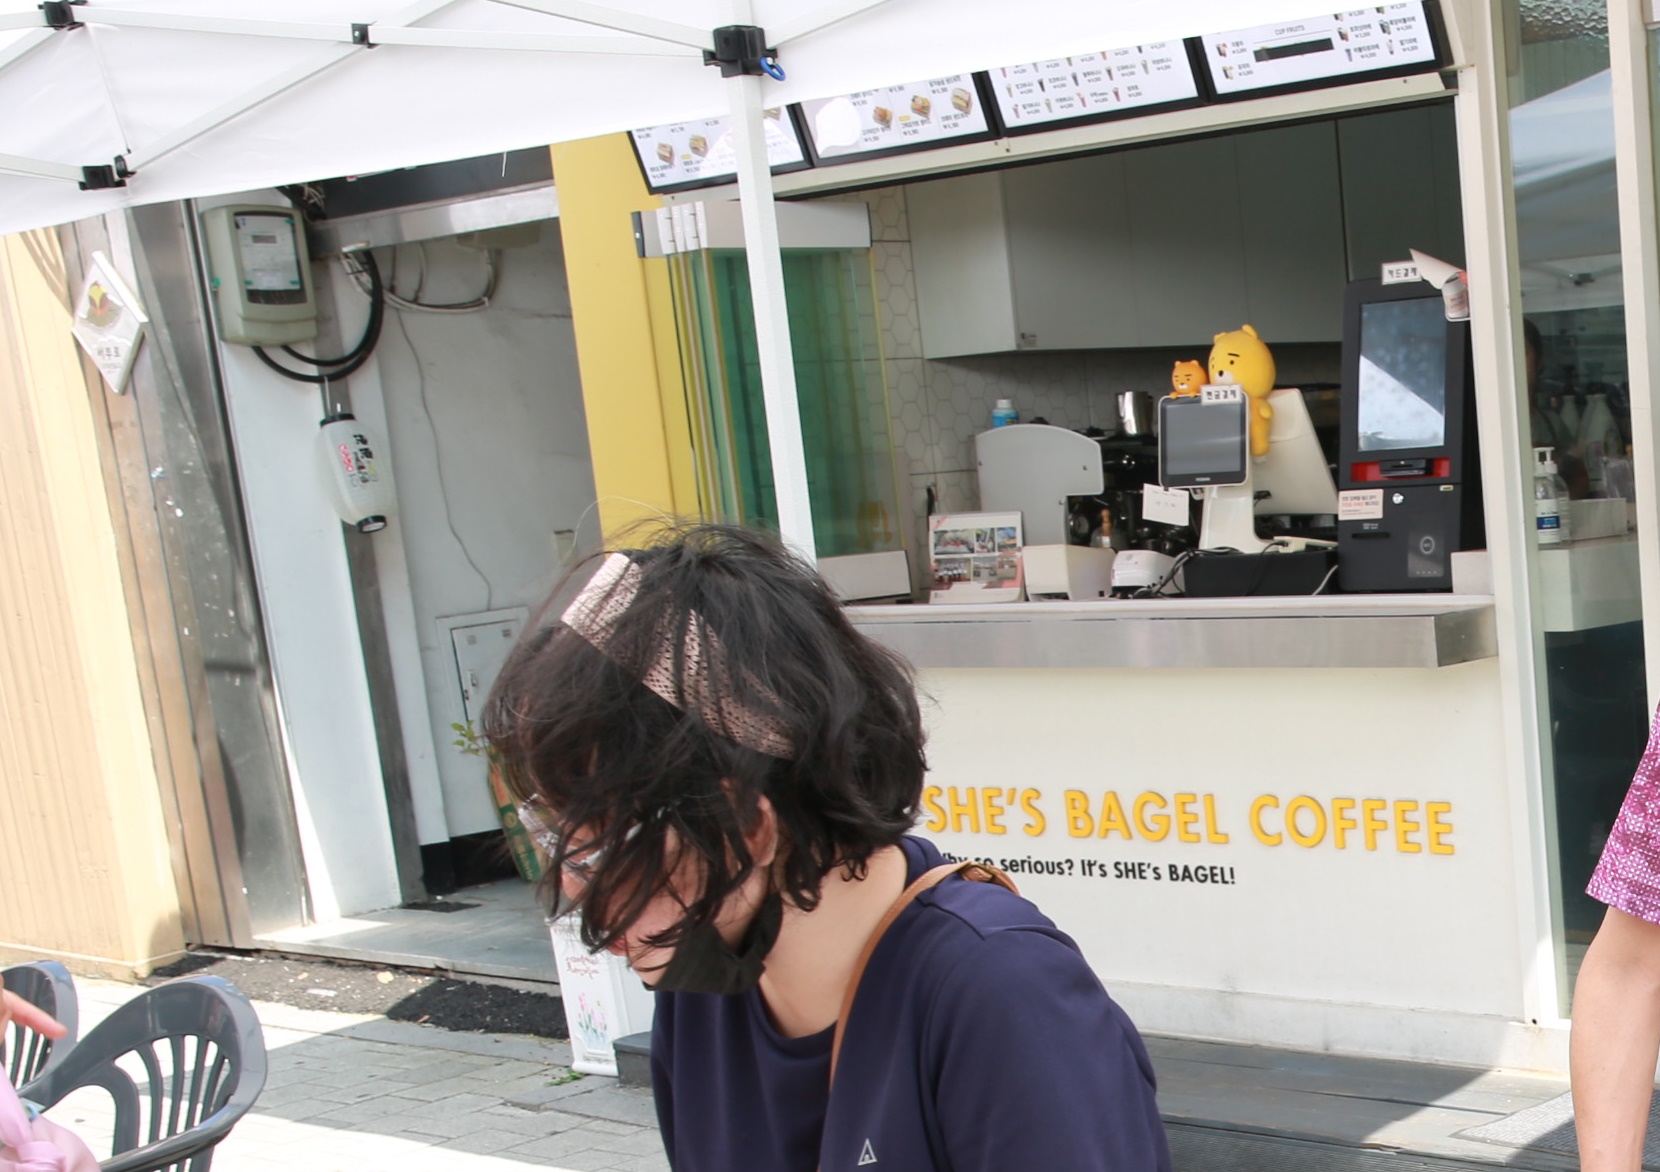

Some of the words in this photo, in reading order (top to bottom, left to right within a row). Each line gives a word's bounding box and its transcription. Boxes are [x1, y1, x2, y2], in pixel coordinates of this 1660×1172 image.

[921, 785, 1046, 837] SHE'S
[1064, 789, 1229, 845] BAGEL
[1248, 794, 1455, 855] COFFEE
[1000, 854, 1074, 876] serious?
[1081, 858, 1107, 878] It's
[1113, 861, 1162, 882] SHE's
[1168, 863, 1236, 885] BAGEL!
